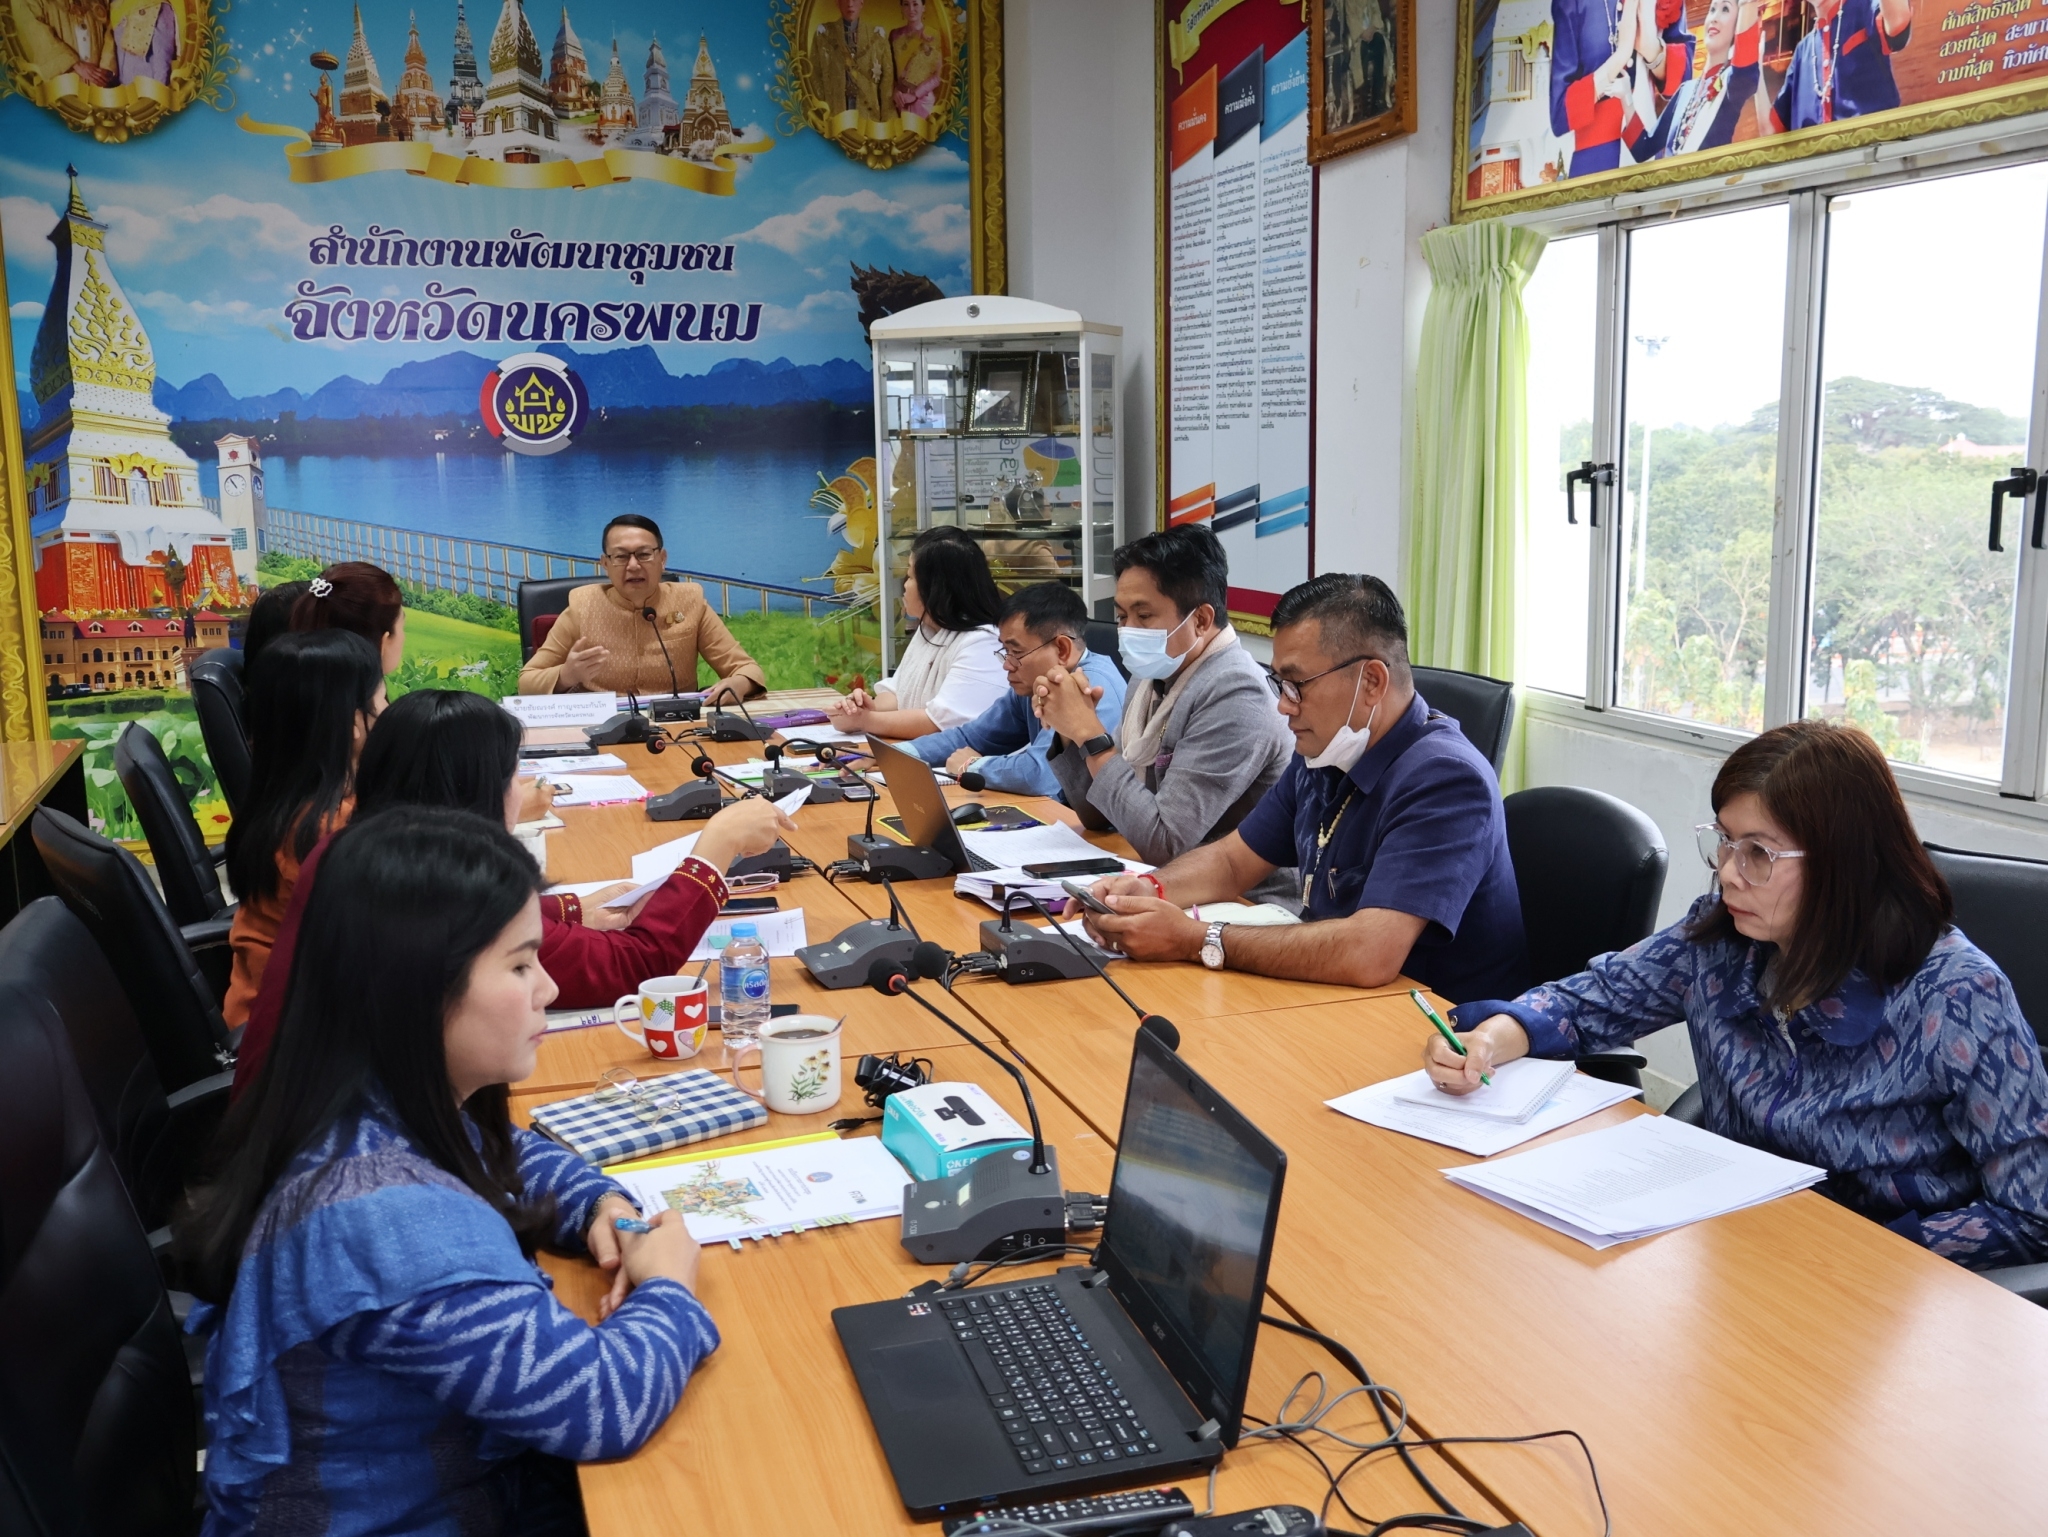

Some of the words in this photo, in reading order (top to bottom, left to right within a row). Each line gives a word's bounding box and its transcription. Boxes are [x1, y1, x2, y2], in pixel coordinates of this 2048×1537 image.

[1940, 25, 1997, 57] สวยที่สุด
[1938, 53, 1994, 83] งามที่สุด
[1225, 85, 1256, 114] ความมั่งคั่ง
[308, 225, 736, 286] สำนักงานพัฒนาชุมชน
[284, 280, 763, 342] จังหวัดนครพนม
